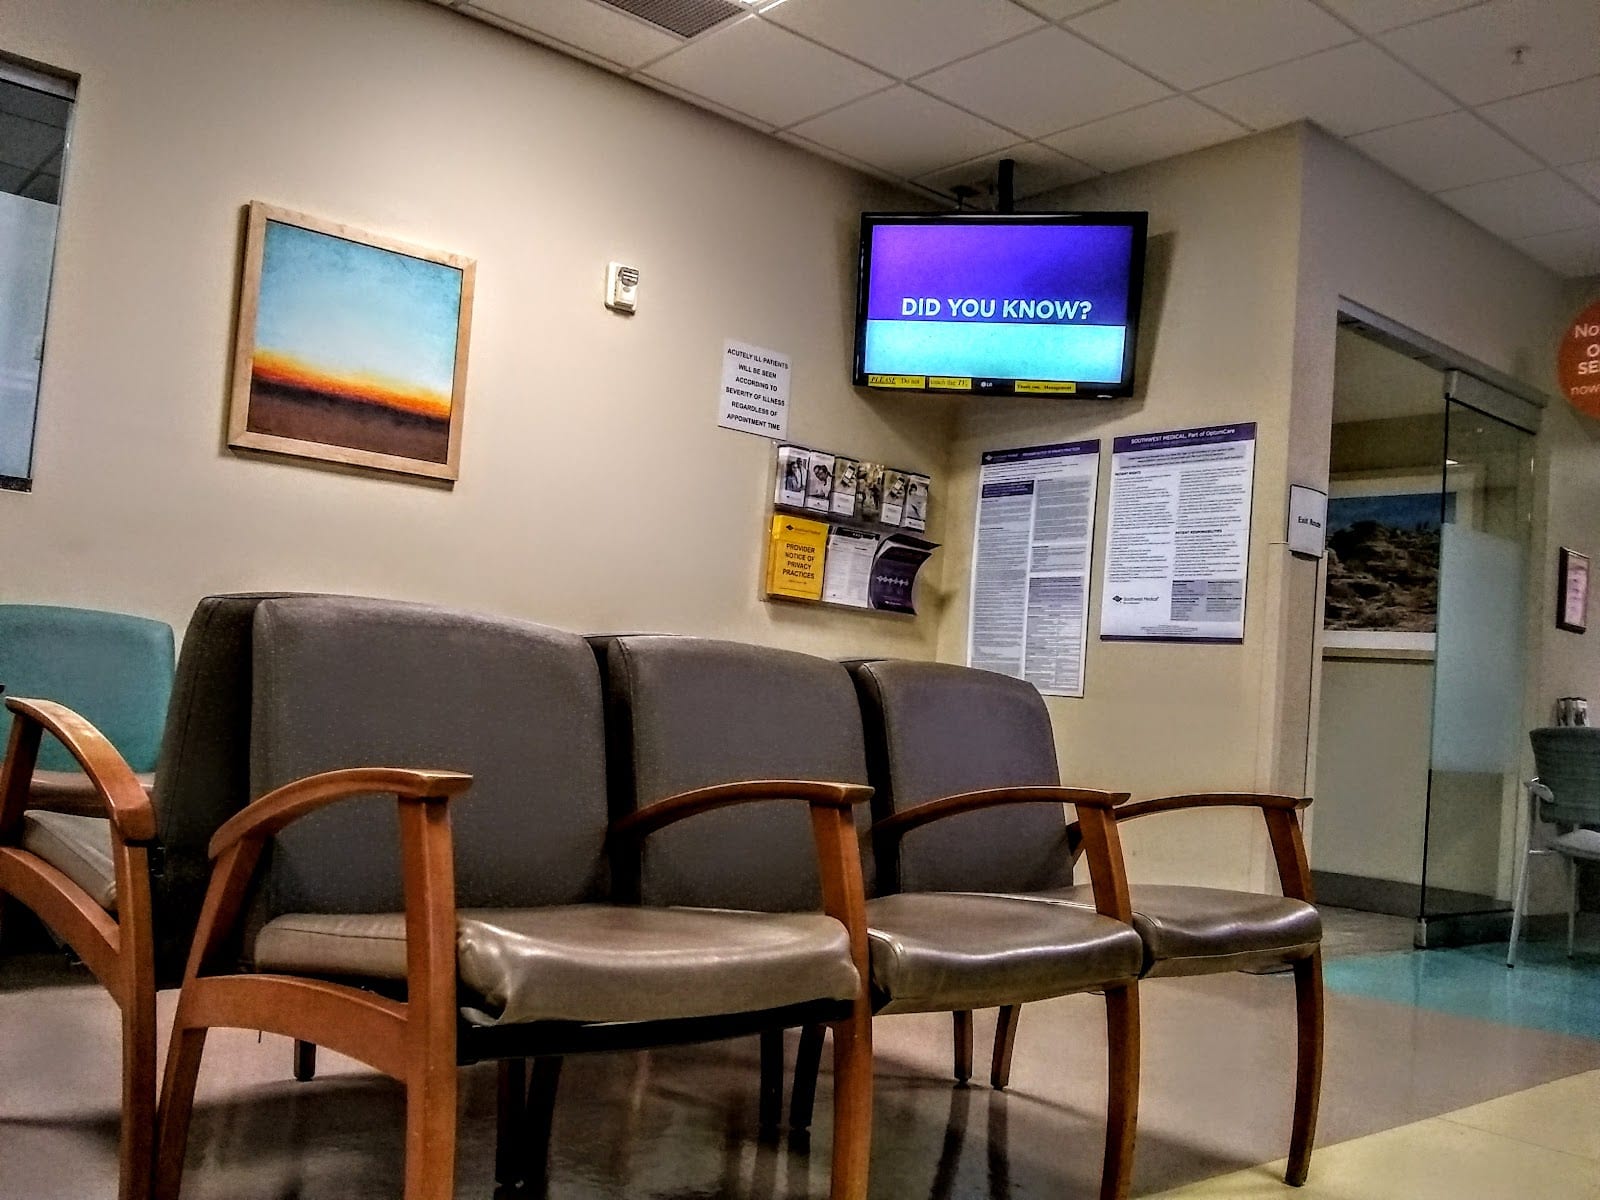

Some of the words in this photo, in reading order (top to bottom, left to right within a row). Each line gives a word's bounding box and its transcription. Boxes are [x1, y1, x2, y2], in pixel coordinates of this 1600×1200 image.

[901, 297, 941, 317] DID
[948, 298, 996, 318] YOU
[1002, 299, 1092, 320] KNOW?
[727, 348, 753, 360] ACUTELY
[763, 357, 789, 370] PATIENTS
[738, 363, 752, 373] WILL
[752, 367, 761, 375] BE
[1577, 360, 1600, 375] SE
[735, 376, 769, 389] ACCORDING
[770, 384, 778, 392] TO
[726, 386, 753, 398] SEVERITY
[762, 395, 785, 407] ILLNESS
[731, 401, 769, 416] REGARDLESS
[726, 413, 767, 427] APPOINTMENT
[767, 422, 781, 431] TIME
[1131, 436, 1162, 444] SOUTHWEST
[1298, 516, 1308, 524] Exit
[786, 543, 816, 553] PROVIDER
[785, 552, 805, 561] NOTICE
[787, 561, 812, 570] PRIVACY
[782, 568, 815, 579] PRACTICES
